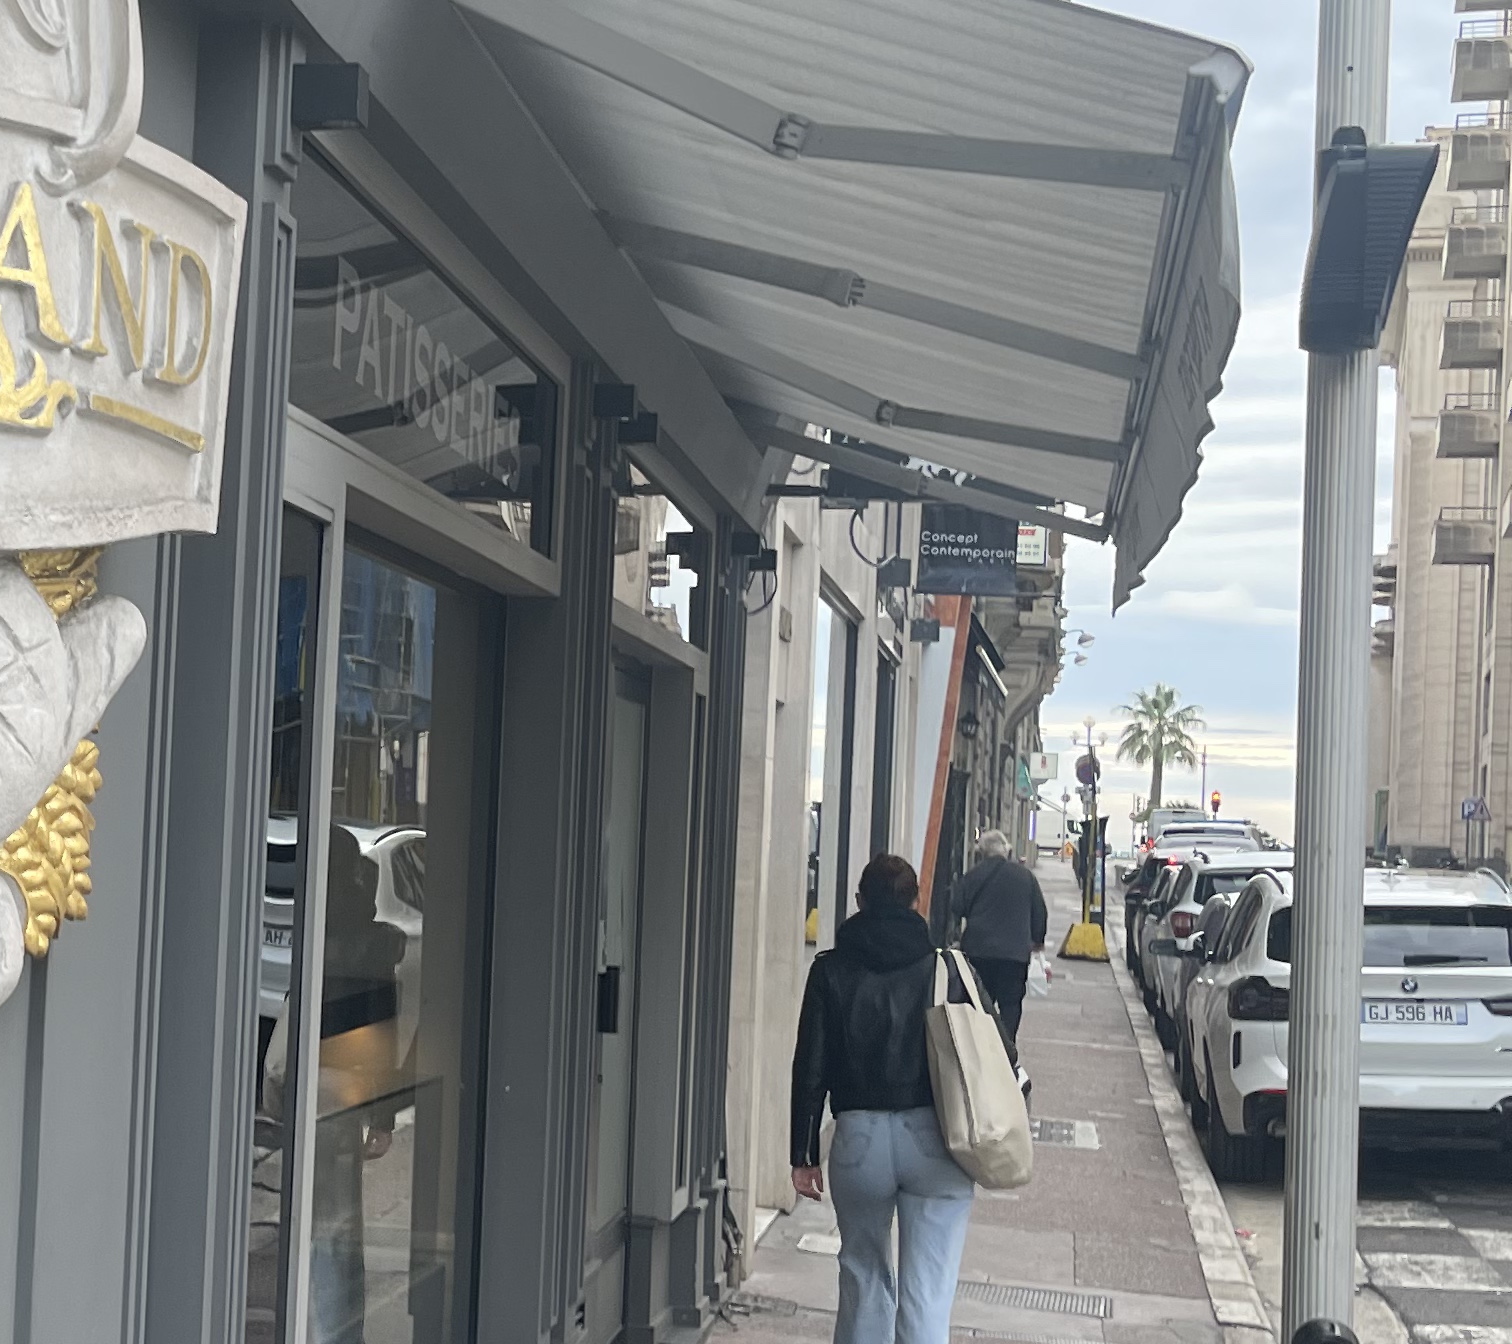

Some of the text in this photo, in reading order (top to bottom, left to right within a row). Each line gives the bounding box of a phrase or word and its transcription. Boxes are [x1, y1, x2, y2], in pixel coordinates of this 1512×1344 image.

[332, 255, 522, 492] PATISSERIES
[921, 531, 979, 545] Concept
[920, 544, 1016, 559] Contemporain
[1369, 1005, 1454, 1022] GJ 596 HA
